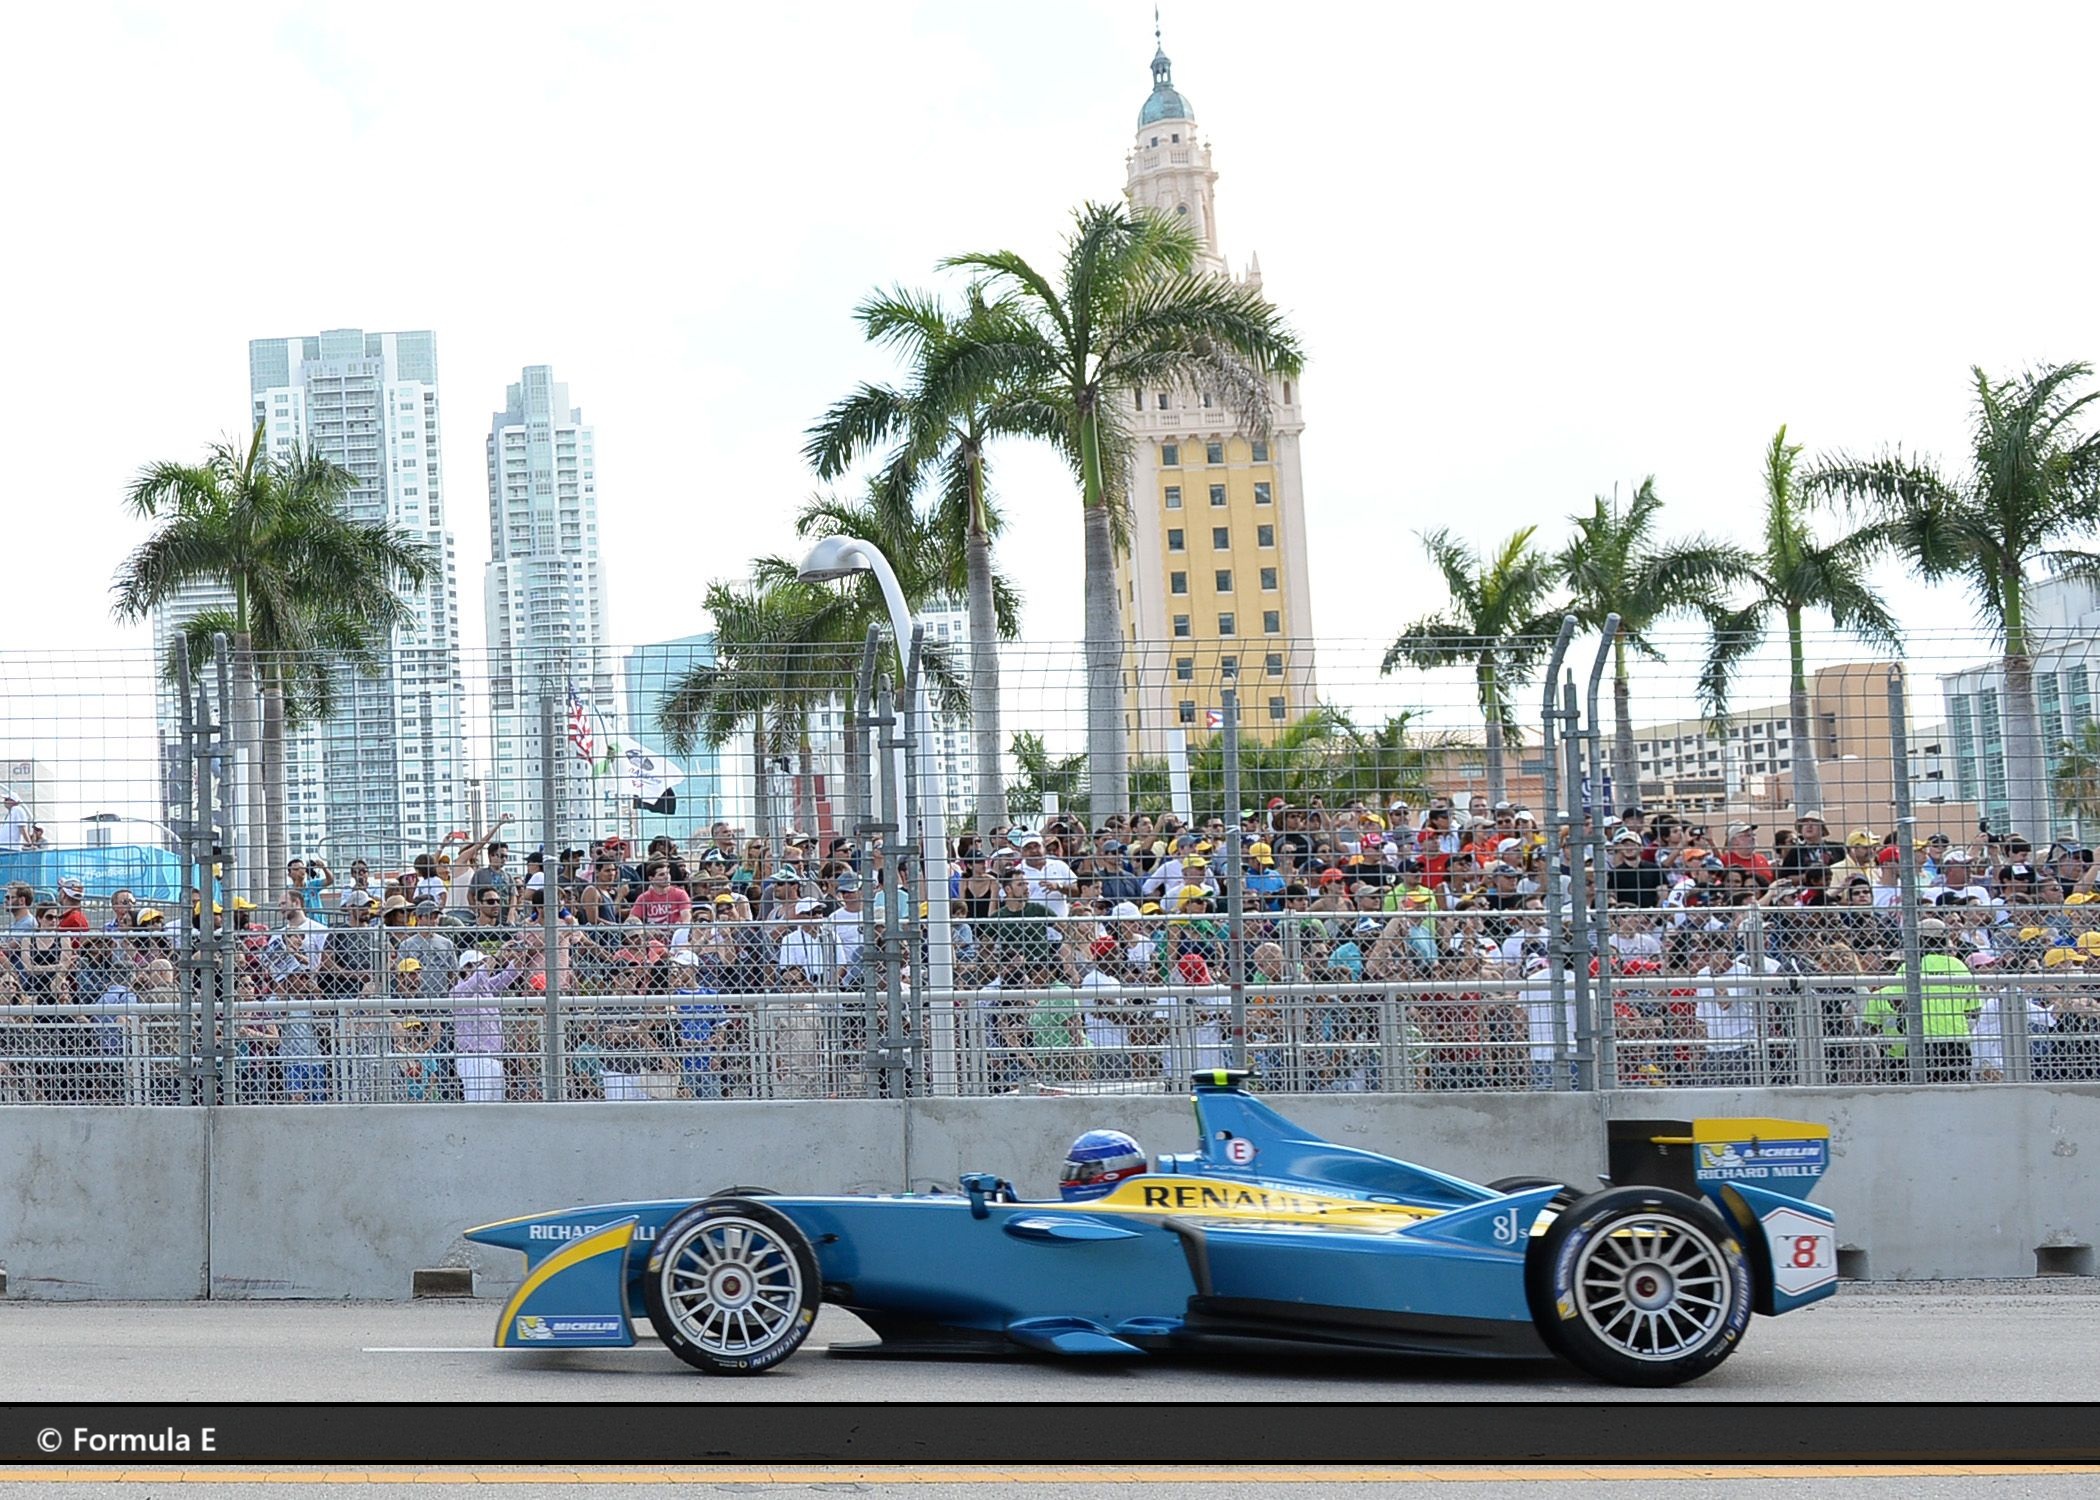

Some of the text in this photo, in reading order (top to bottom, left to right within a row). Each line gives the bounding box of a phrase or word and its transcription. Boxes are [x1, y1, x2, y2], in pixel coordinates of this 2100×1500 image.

[1233, 1142, 1246, 1160] E
[1697, 1165, 1822, 1180] RICHARD MILLE
[1792, 1235, 1818, 1269] 8
[552, 1322, 619, 1331] MICHELIN
[752, 1327, 803, 1367] MICHELIN
